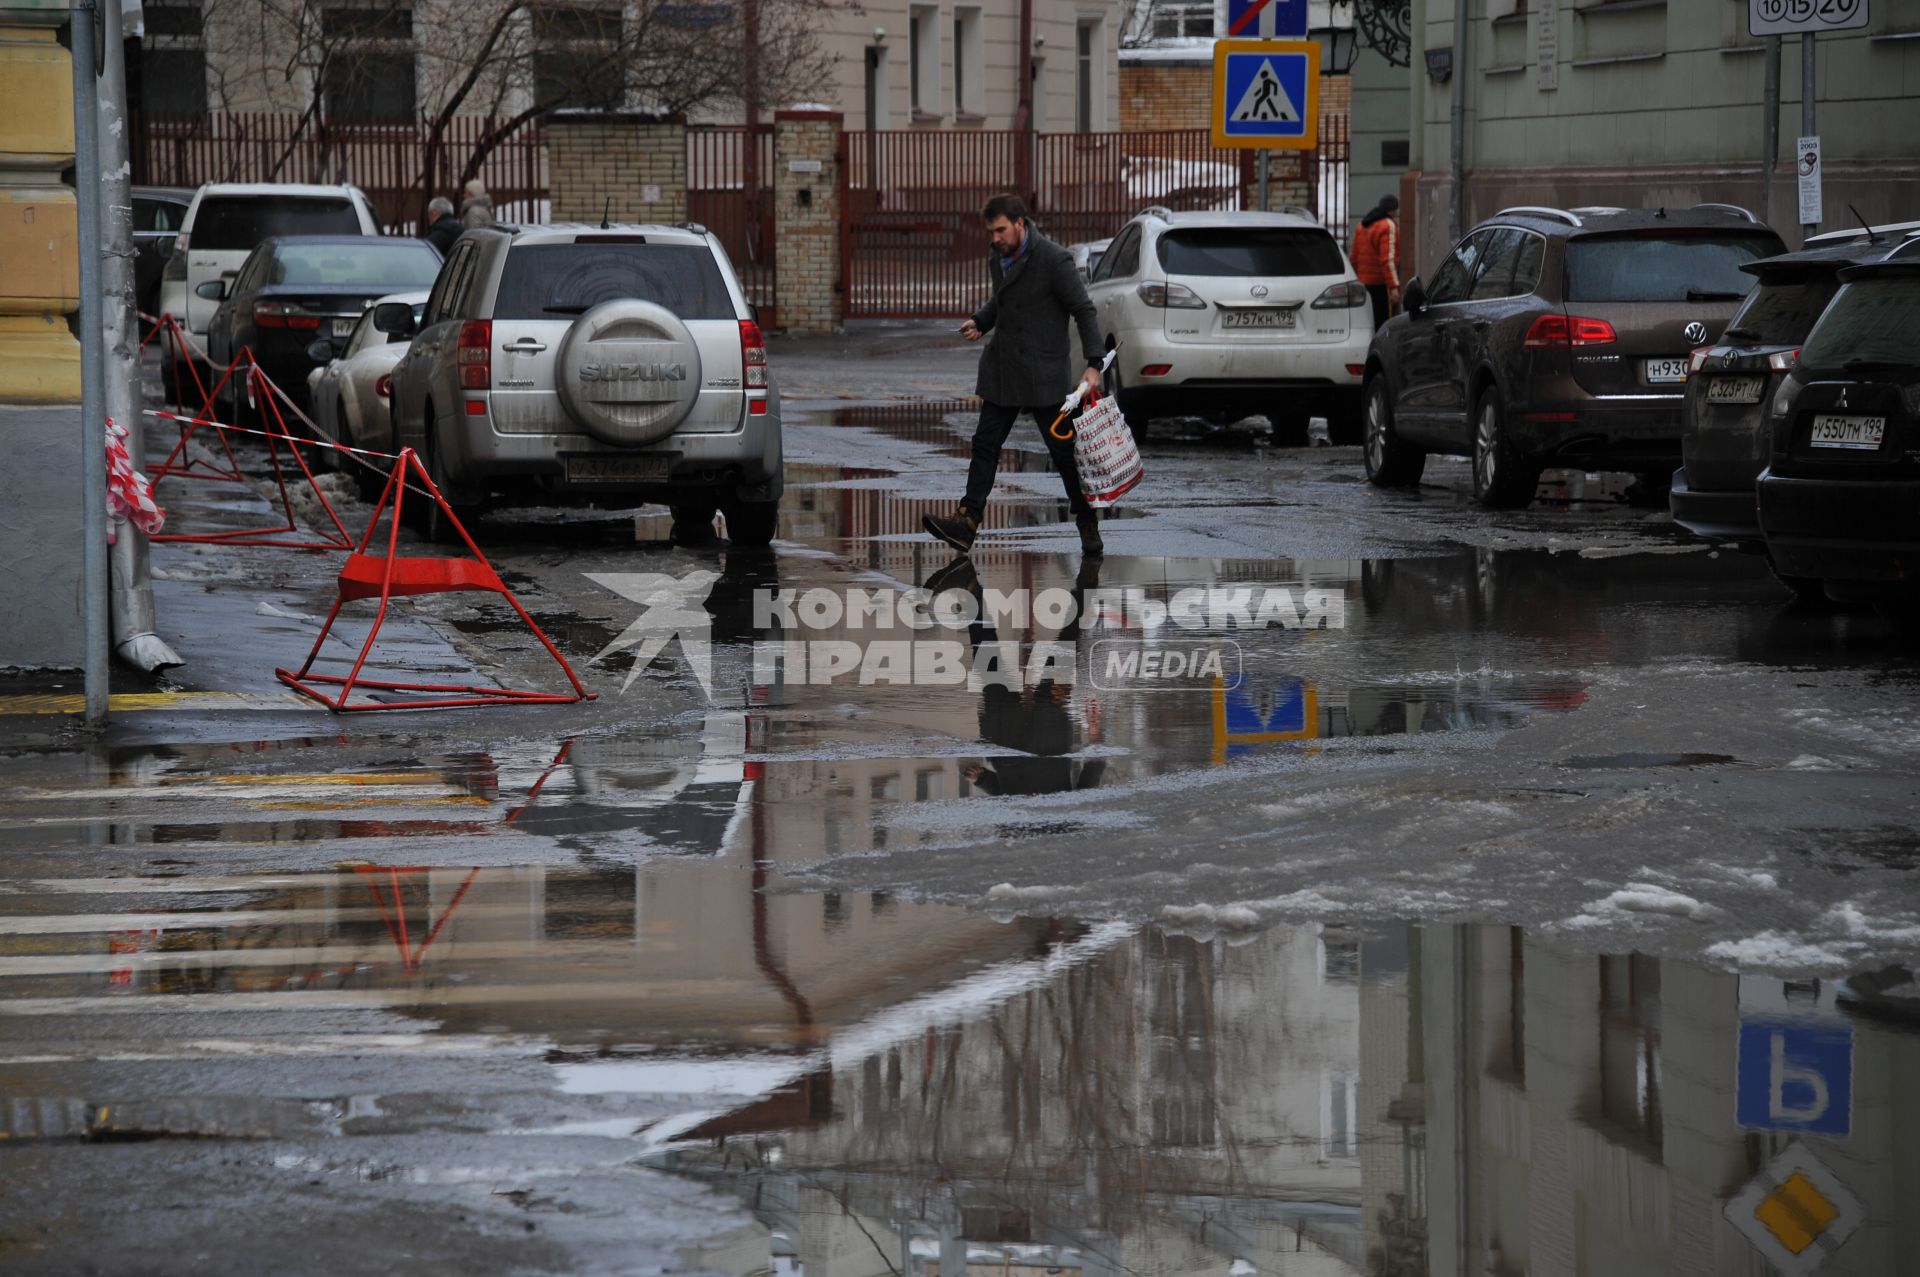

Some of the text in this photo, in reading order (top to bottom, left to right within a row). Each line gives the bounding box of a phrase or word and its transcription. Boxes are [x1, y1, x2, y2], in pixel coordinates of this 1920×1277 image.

[1764, 0, 1852, 15] 10 15 20
[579, 363, 687, 382] SUZUKI
